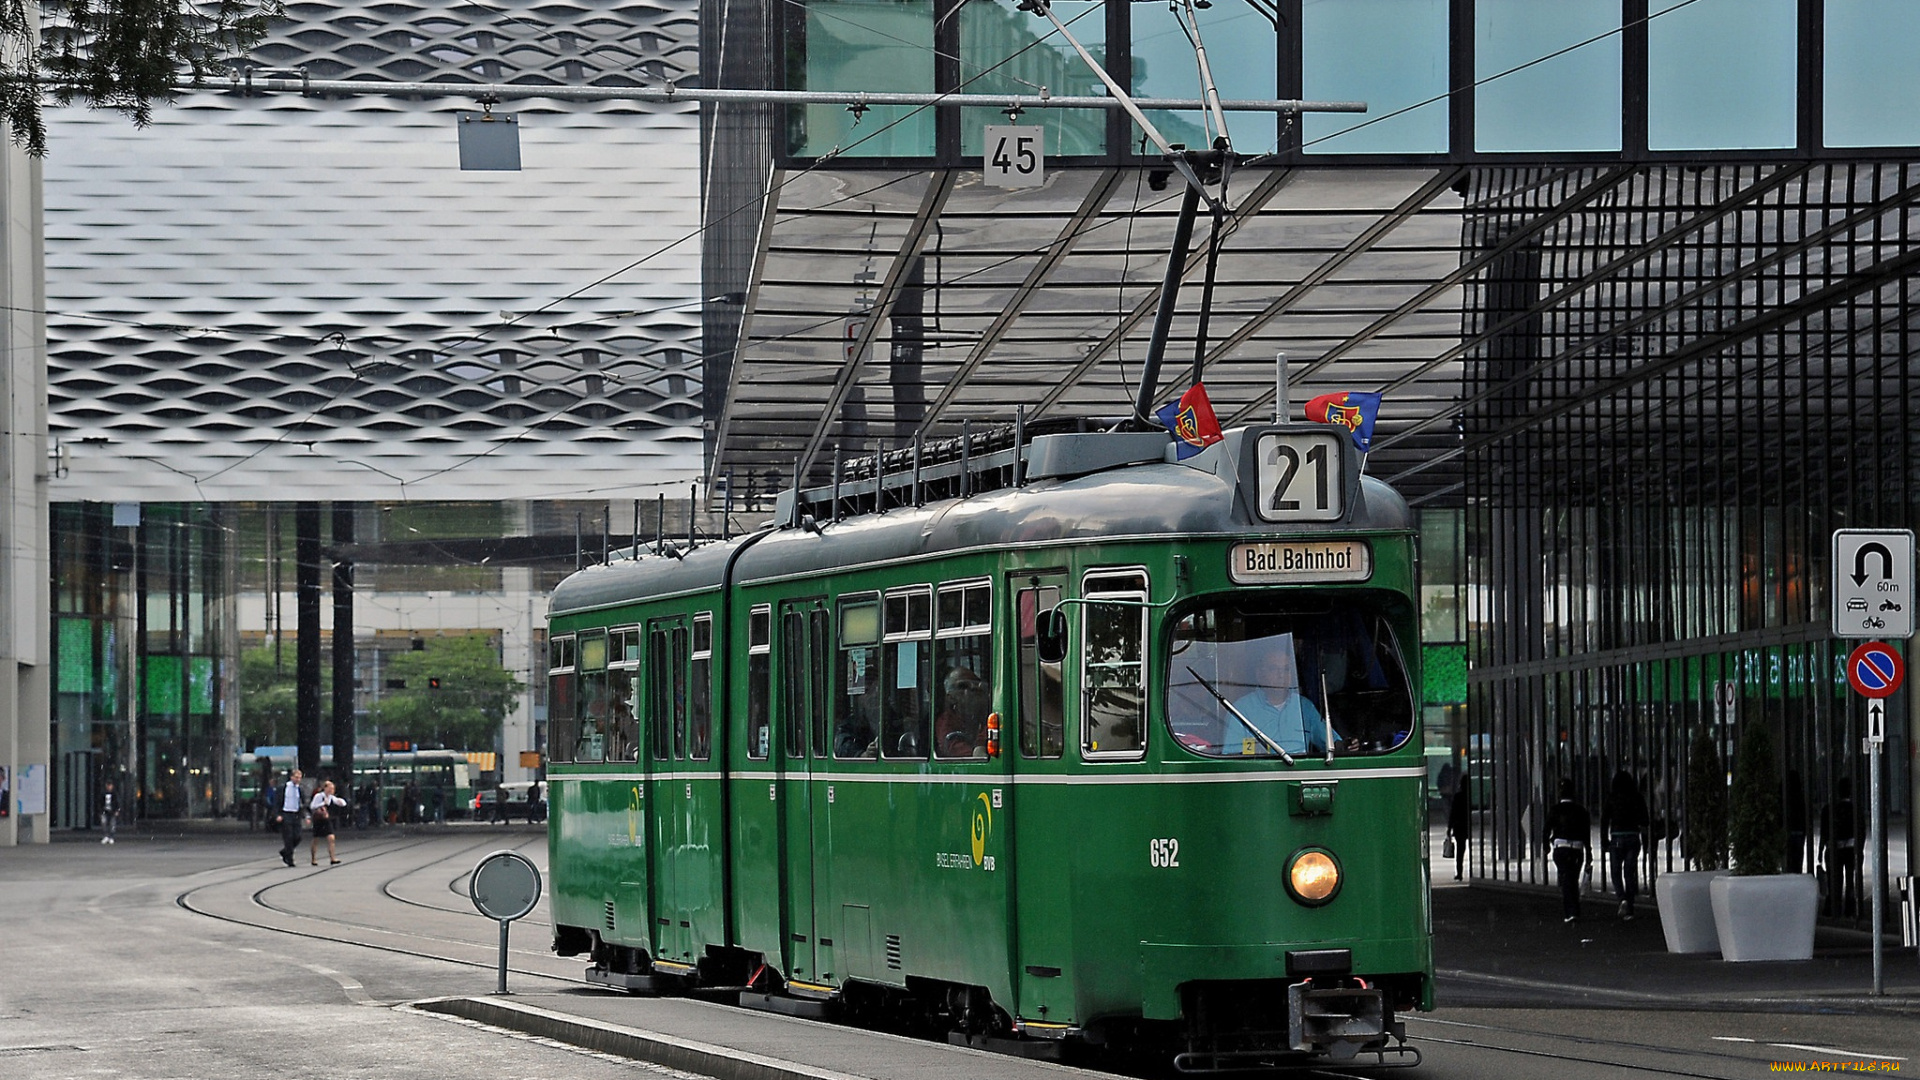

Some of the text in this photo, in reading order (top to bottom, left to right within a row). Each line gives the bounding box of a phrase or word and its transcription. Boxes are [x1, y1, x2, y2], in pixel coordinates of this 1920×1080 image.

[991, 136, 1036, 175] 45
[1267, 444, 1329, 511] 21
[1150, 838, 1179, 867] 652
